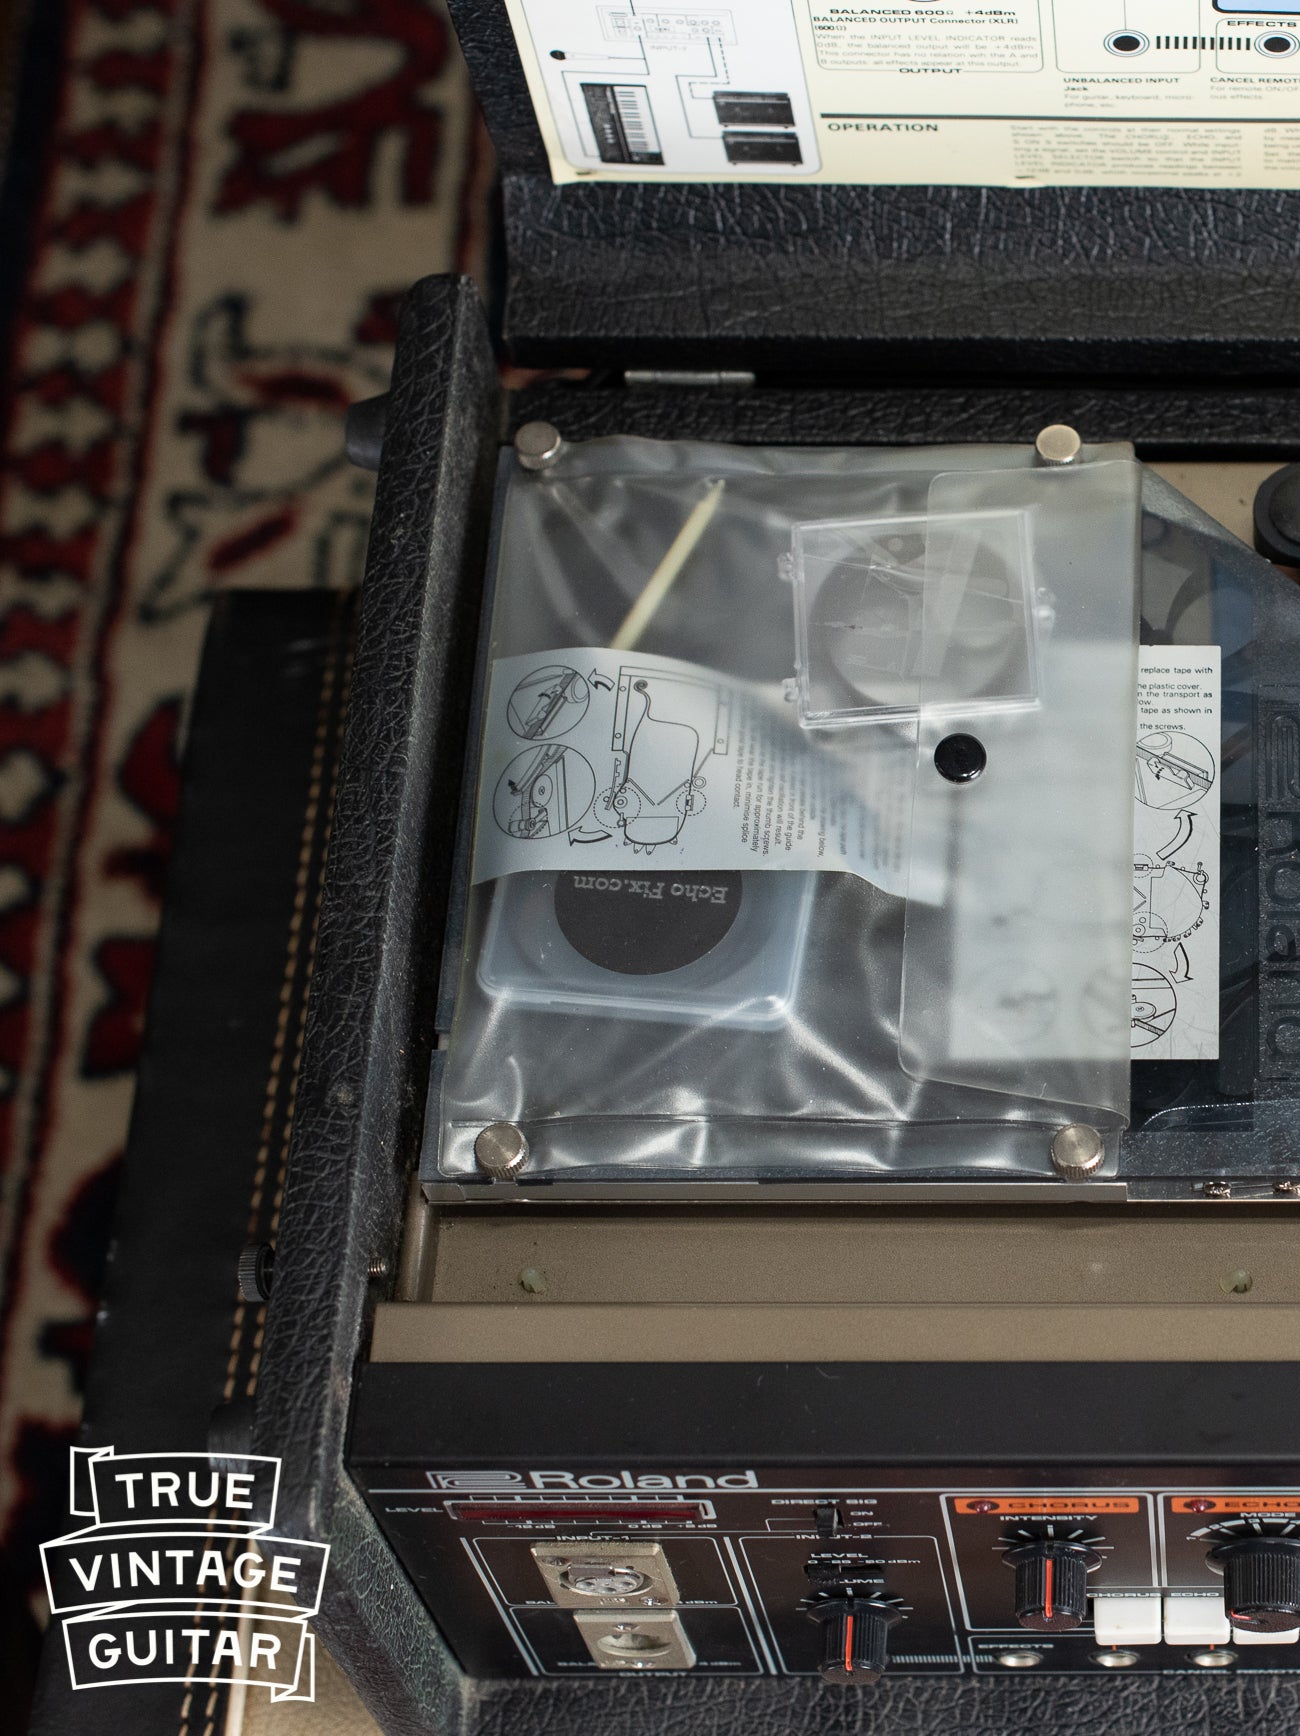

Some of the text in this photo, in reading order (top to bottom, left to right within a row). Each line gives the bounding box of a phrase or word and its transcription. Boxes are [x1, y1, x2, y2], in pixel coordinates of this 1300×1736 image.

[930, 17, 986, 25] Connector
[1227, 20, 1297, 28] EFFECTS
[828, 122, 939, 132] OPERATION
[1140, 666, 1213, 675] replace tape with
[1140, 707, 1159, 715] tape
[1173, 706, 1202, 714] shown
[1204, 706, 1213, 714] in
[1140, 722, 1153, 730] the
[741, 822, 750, 843] splice
[750, 803, 763, 853] approximately
[762, 829, 771, 857] screws.
[785, 832, 793, 851] guide
[574, 875, 729, 904] Echo Fix.com
[529, 1470, 759, 1489] Roland
[1008, 1501, 1129, 1509] CHORUS
